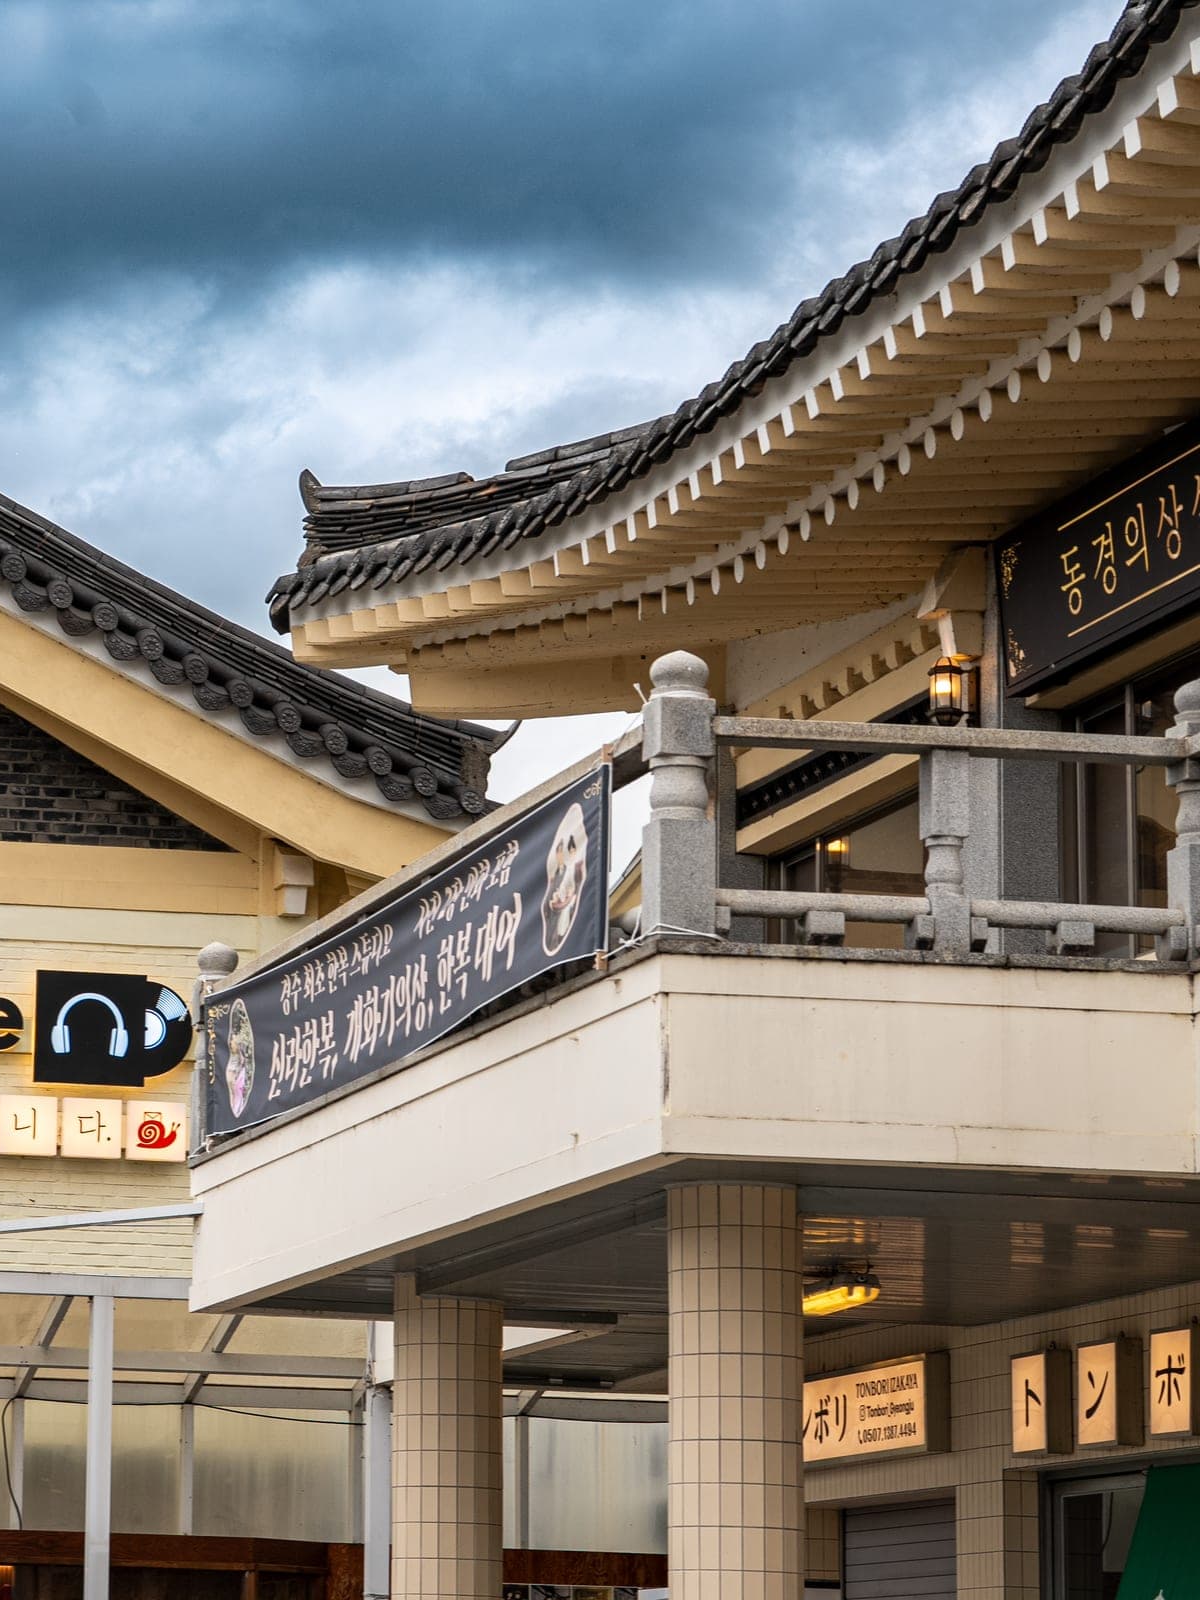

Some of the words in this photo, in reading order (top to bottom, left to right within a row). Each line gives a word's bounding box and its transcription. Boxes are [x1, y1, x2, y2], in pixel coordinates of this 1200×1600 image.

[1060, 475, 1200, 615] 동경의상
[280, 972, 302, 1015] 경주
[303, 959, 325, 1003] 최초
[326, 945, 349, 994] 한복
[350, 924, 395, 976] 스튜디오
[474, 892, 522, 983] 대여
[856, 1379, 890, 1399] TONBORI
[890, 1373, 919, 1393] IZAKAYA
